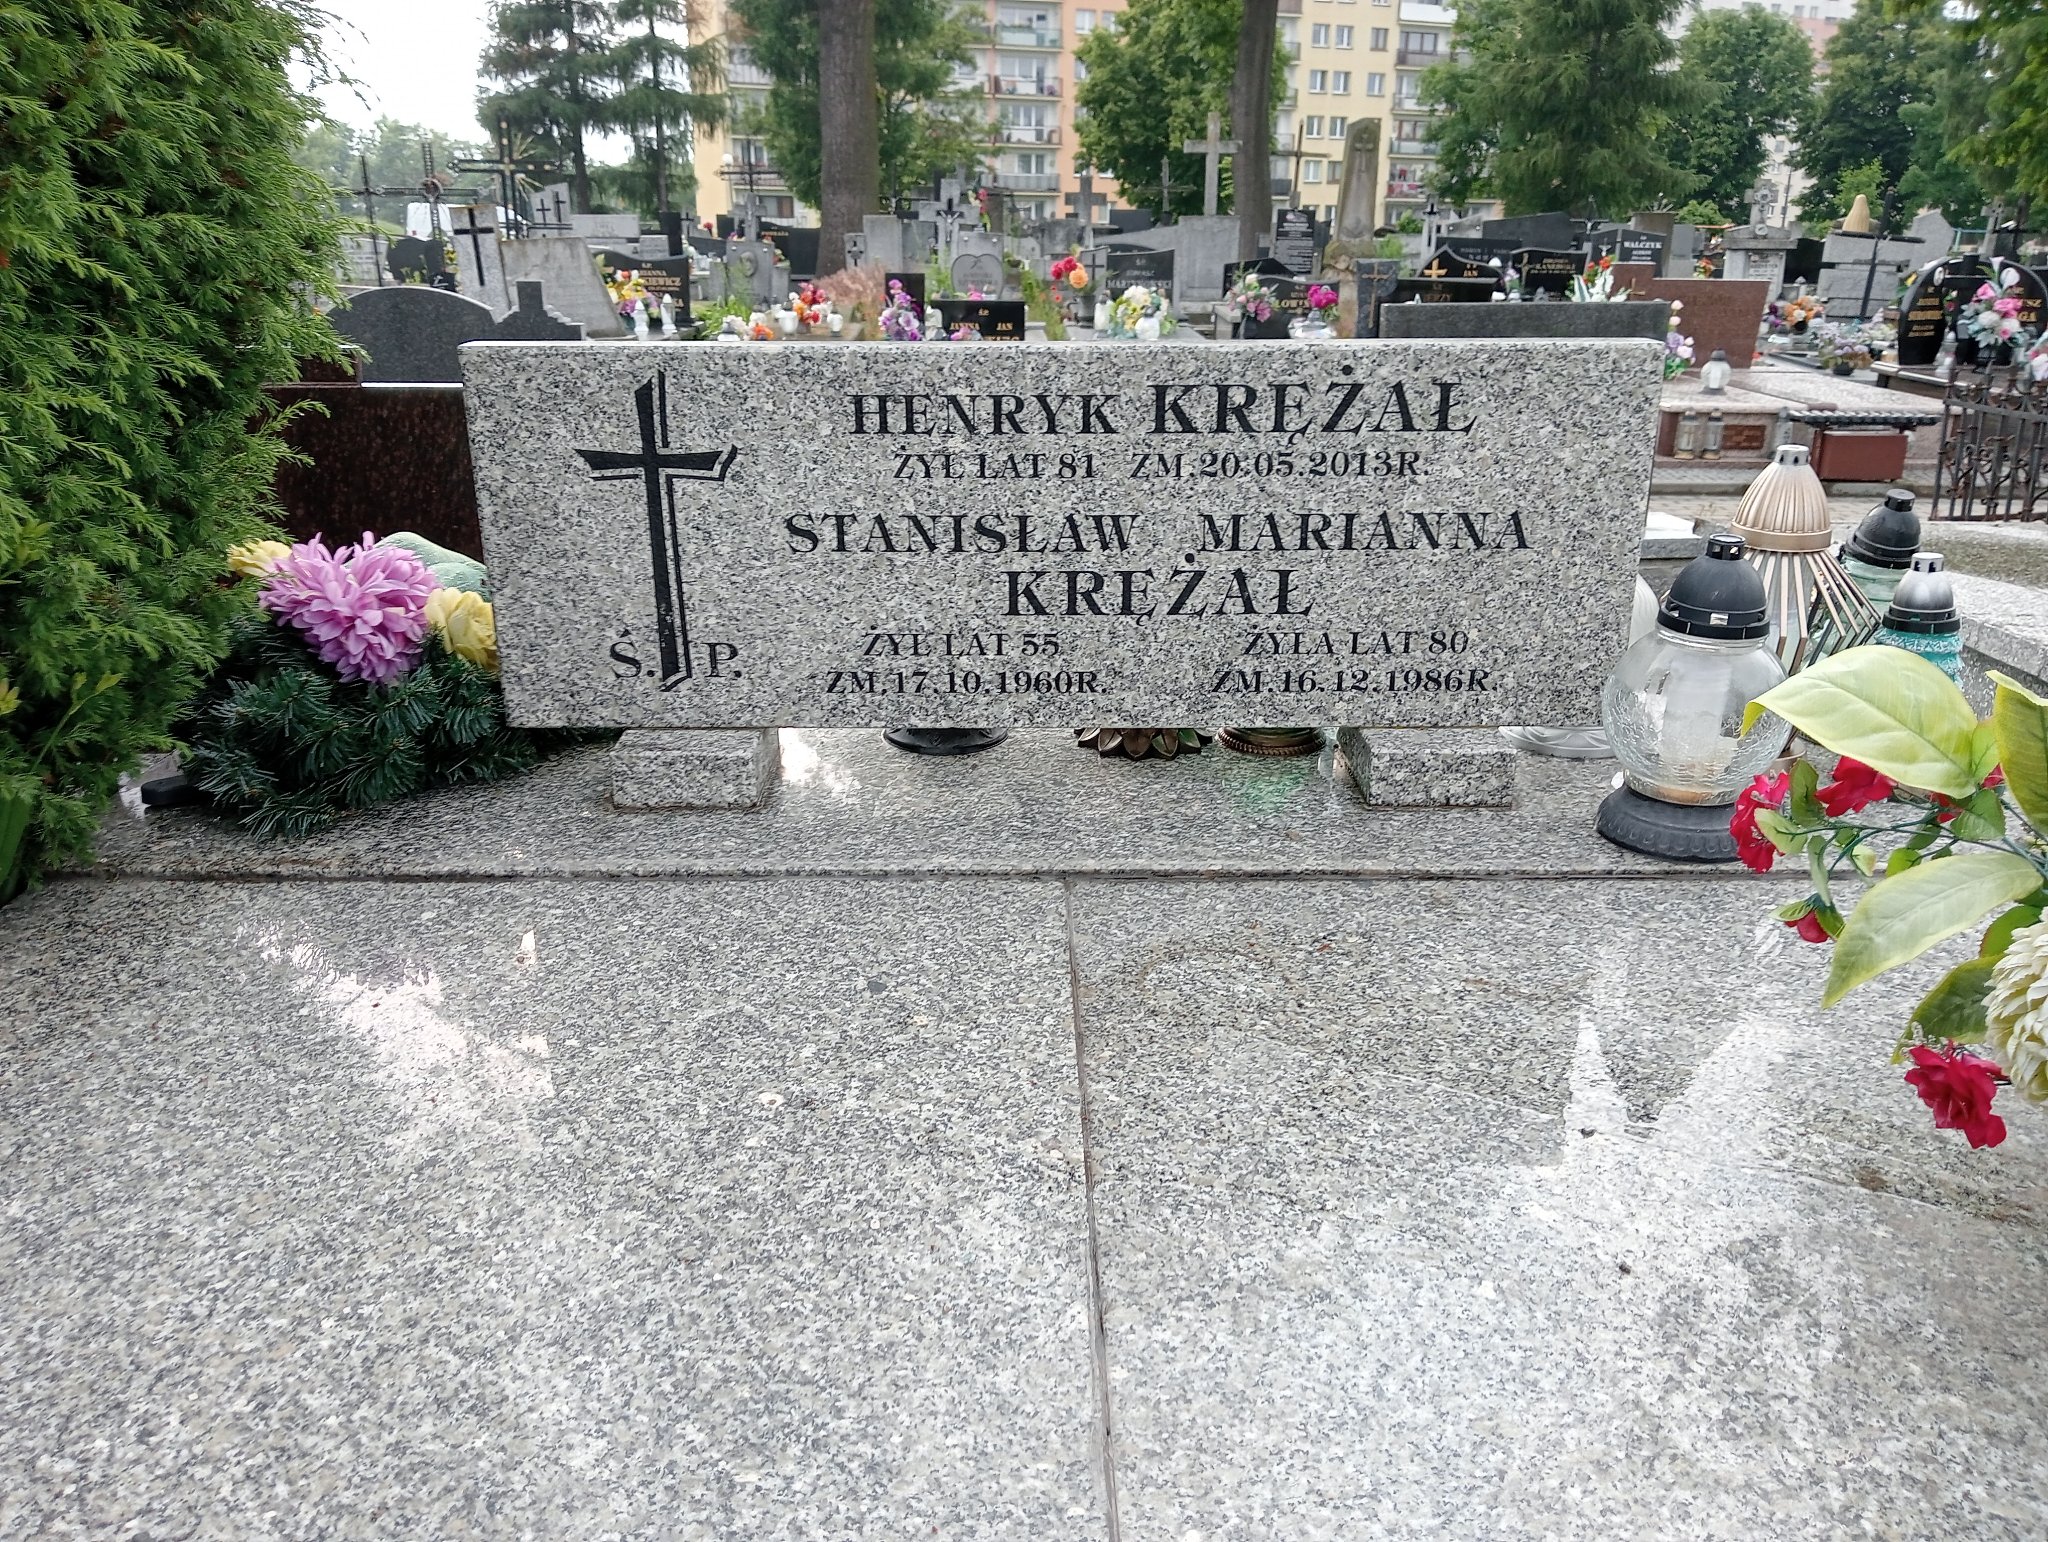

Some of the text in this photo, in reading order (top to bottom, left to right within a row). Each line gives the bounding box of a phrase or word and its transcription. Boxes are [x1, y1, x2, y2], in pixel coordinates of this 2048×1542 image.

[848, 365, 1477, 445] HENRYK KRĘŻAŁ
[893, 445, 961, 479] ŻYŁ
[975, 454, 1047, 479] LAT
[1058, 452, 1097, 479] 81
[784, 511, 1534, 554] STANISŁAW MARIANNA
[1001, 553, 1315, 626] KRĘŻAŁ
[863, 626, 1061, 657] ŻYŁ LAT 55
[1243, 625, 1470, 656] ŻYŁA LAT 80
[706, 642, 743, 679] P.
